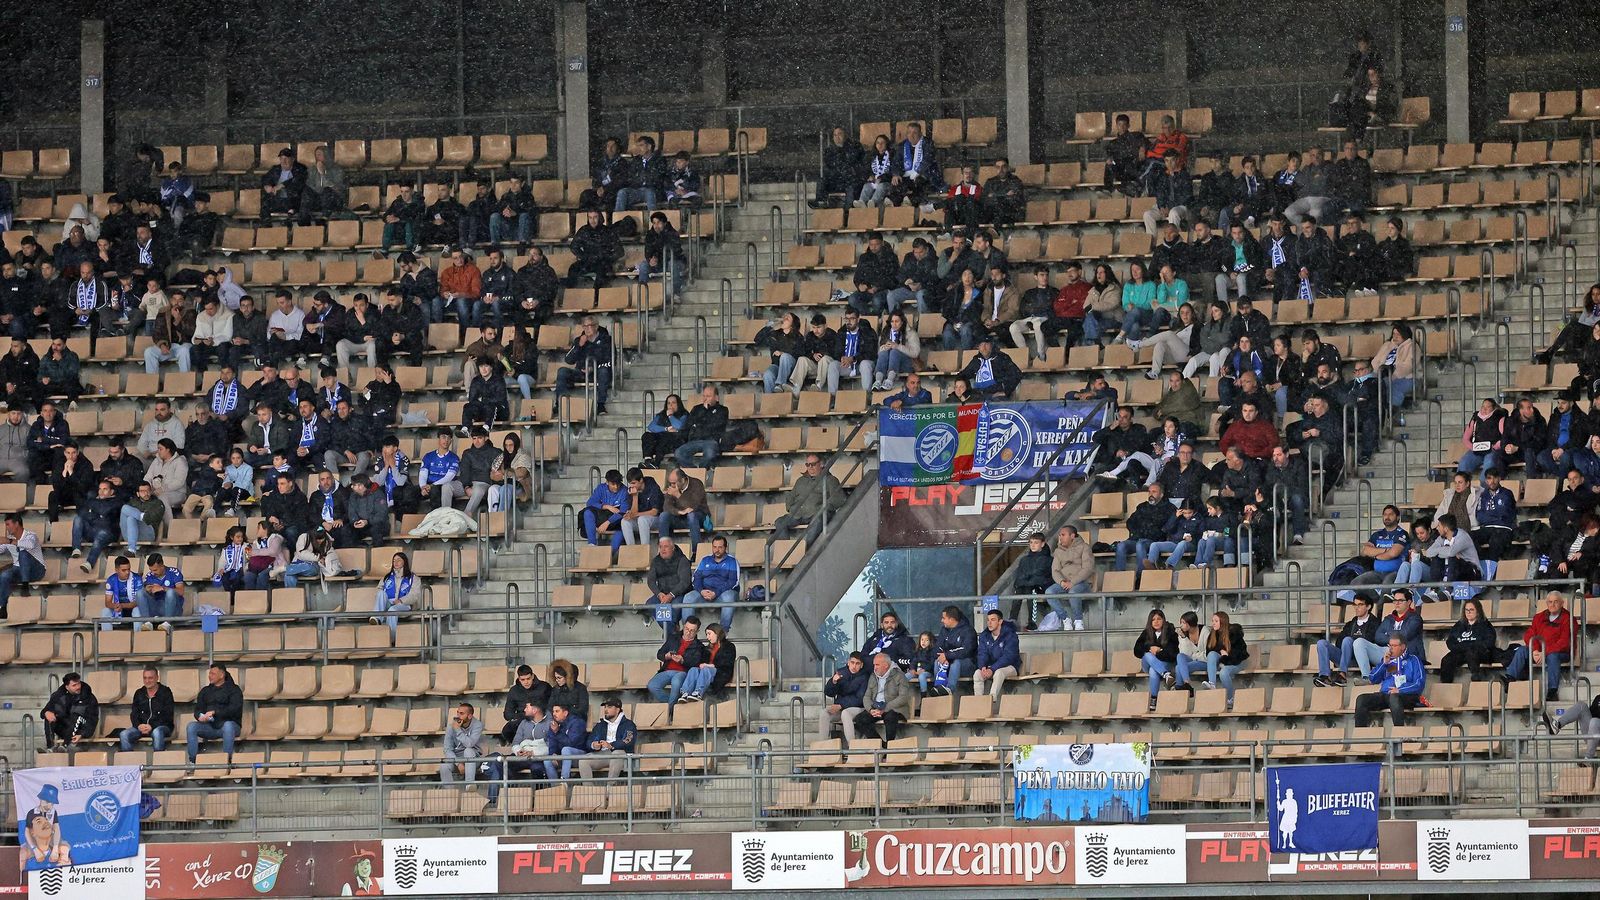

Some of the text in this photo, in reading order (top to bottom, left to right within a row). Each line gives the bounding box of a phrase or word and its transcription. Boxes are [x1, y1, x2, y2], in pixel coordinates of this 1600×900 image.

[1449, 23, 1463, 31] 316
[85, 79, 98, 87] 317
[888, 412, 931, 421] XERECISTAS
[932, 412, 946, 420] POR
[976, 421, 988, 455] FUTSAL
[1035, 431, 1087, 445] XERECTA
[891, 482, 1058, 515] PLAY JEREZ
[1454, 588, 1469, 597] 215
[983, 602, 998, 611] 215
[656, 610, 671, 619] 216
[1017, 767, 1145, 790] PEÑA ABUELO TATO
[1307, 791, 1375, 815] BLUEFEATER
[574, 842, 599, 850] JUEGA,
[1113, 846, 1176, 857] Ayuntamiento
[1455, 842, 1519, 852] Ayuntamiento
[1544, 835, 1600, 859] PLA
[770, 852, 834, 864] Ayuntamiento
[874, 833, 1067, 882] Cruzcampo
[1113, 857, 1149, 867] de Jerez
[1456, 852, 1491, 863] de Jerez
[185, 861, 200, 872] con
[423, 858, 487, 870] Ayuntamiento
[512, 848, 694, 885] PLAY JEREZ
[771, 862, 806, 872] de Jerez
[69, 865, 134, 876] Ayuntamiento
[145, 857, 160, 889] SIN
[423, 868, 459, 878] de Jerez
[82, 875, 106, 885] Jerez
[193, 863, 253, 890] Xerez CD
